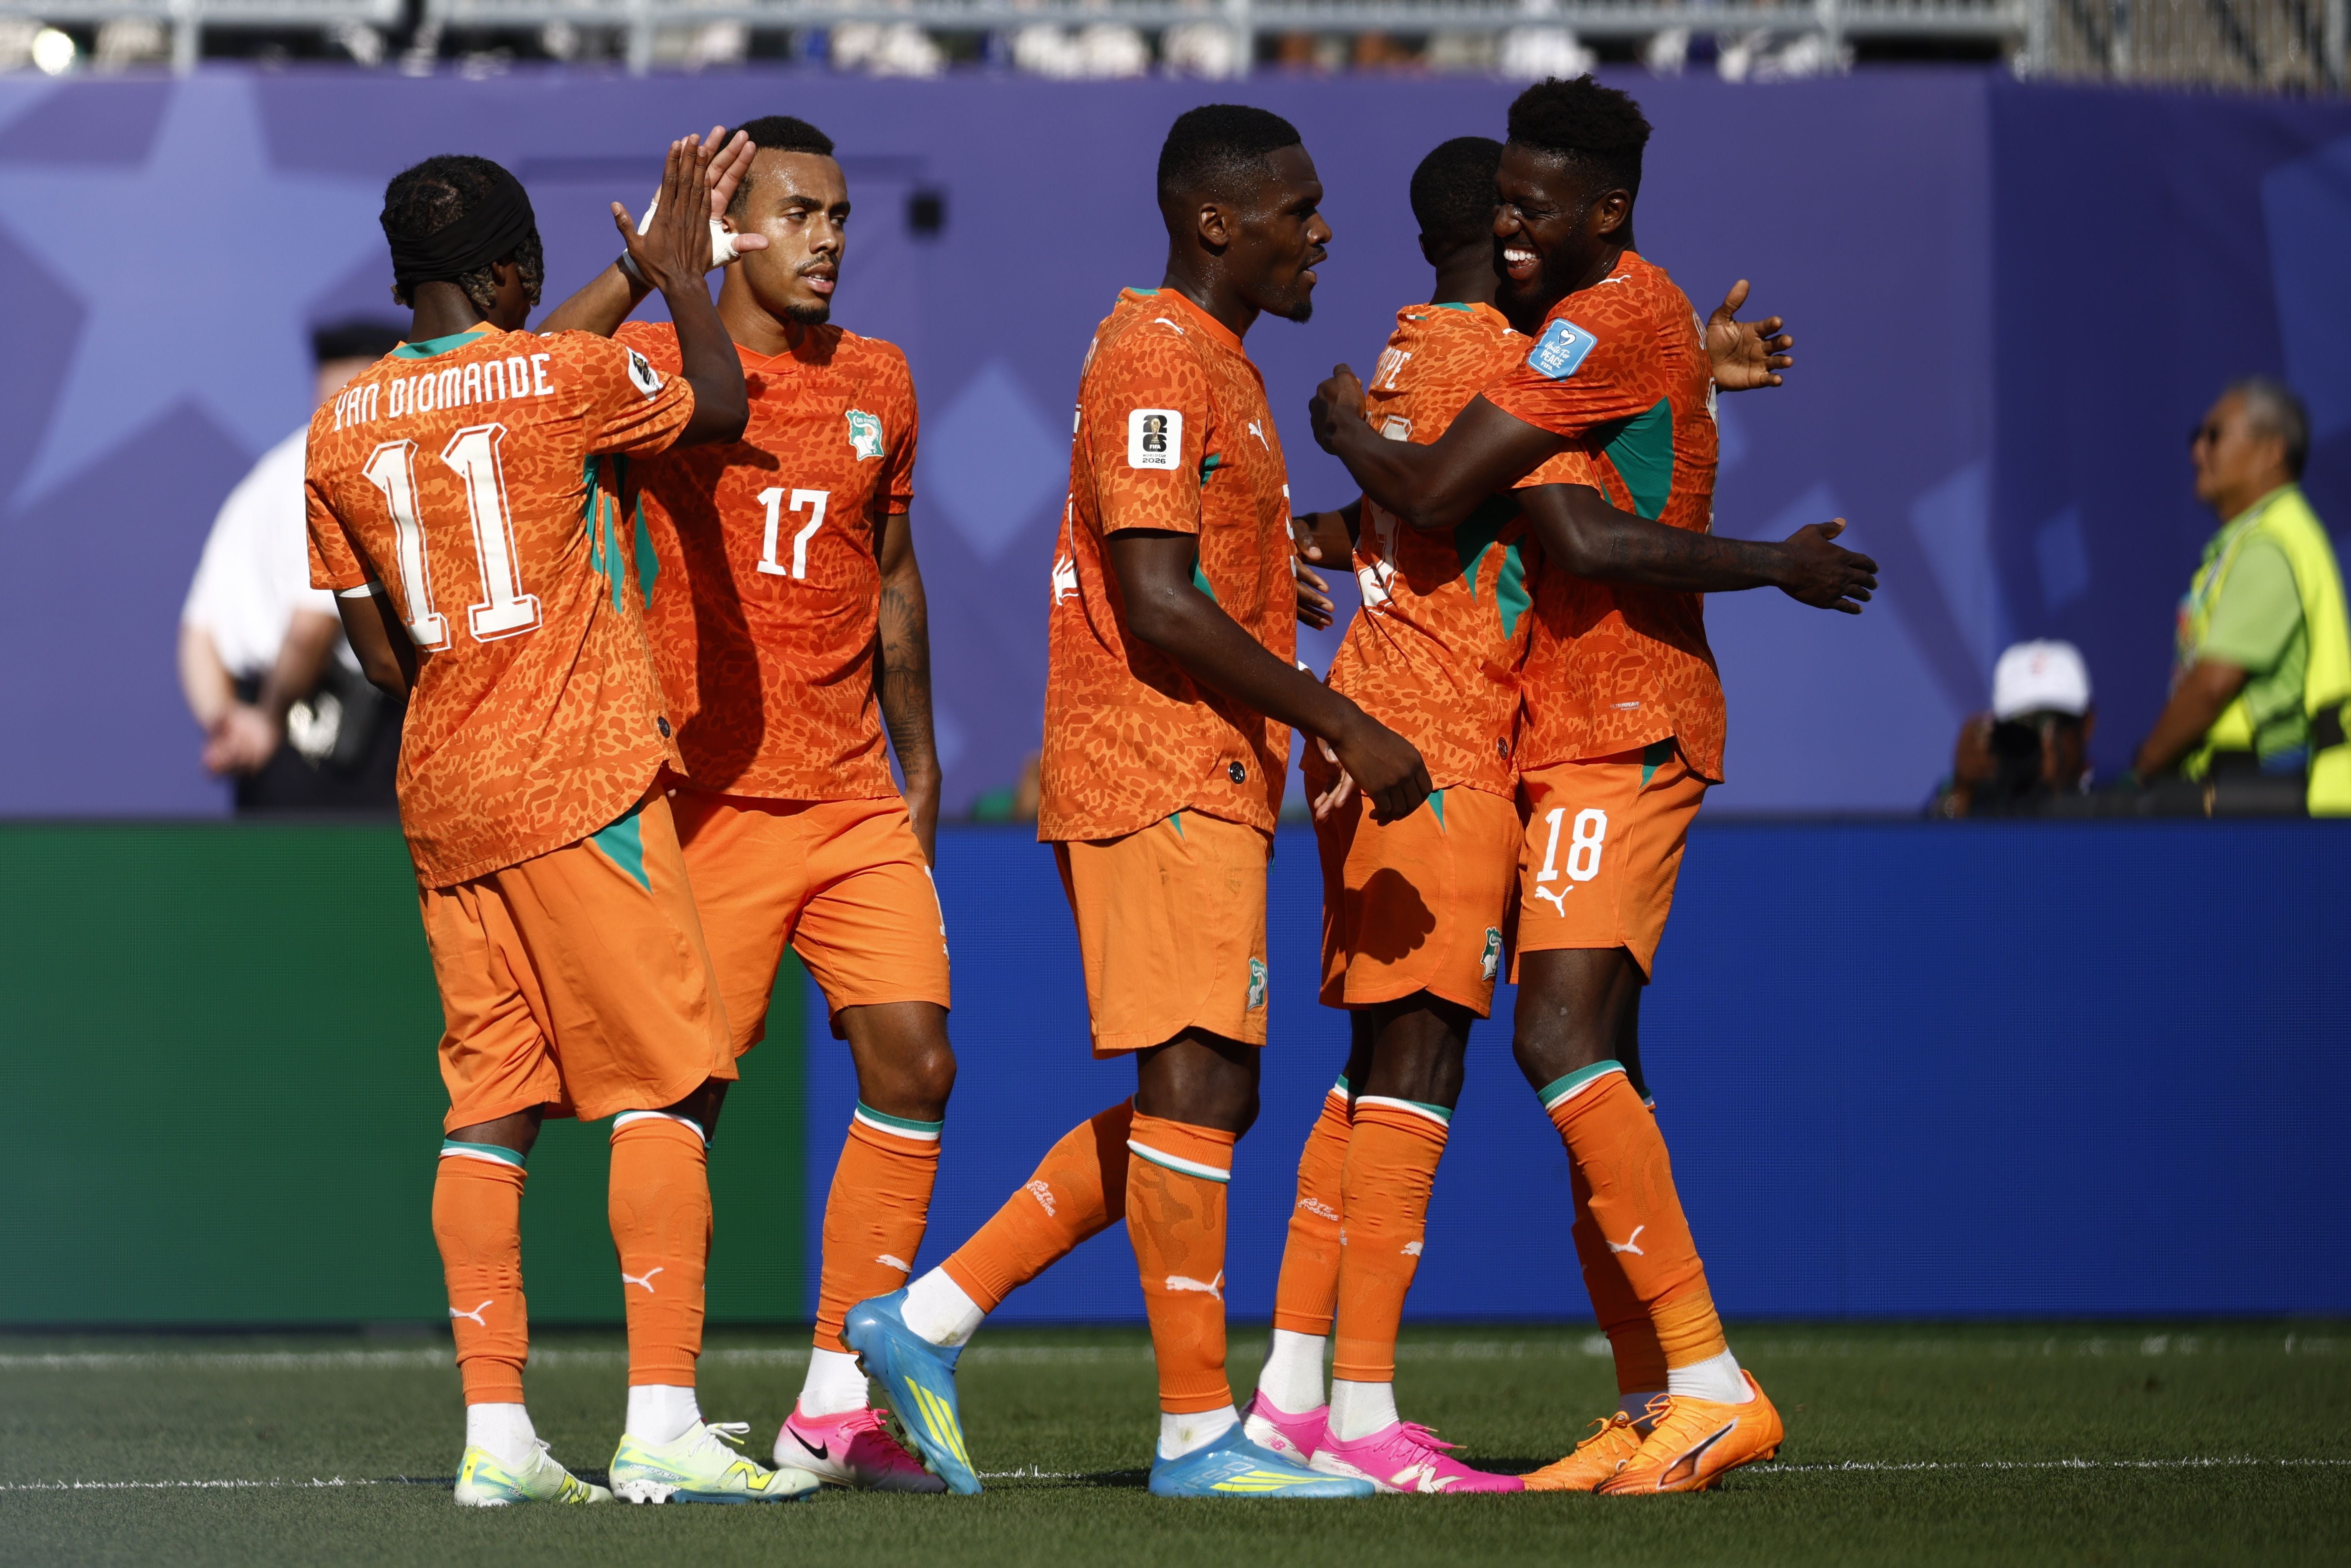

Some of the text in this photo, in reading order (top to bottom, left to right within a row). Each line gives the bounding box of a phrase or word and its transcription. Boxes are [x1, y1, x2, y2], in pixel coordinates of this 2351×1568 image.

[1540, 350, 1565, 369] PEACE
[1540, 361, 1553, 372] FIFA
[1545, 341, 1570, 359] Unite For
[334, 353, 554, 432] YAN DIOMANDE
[361, 422, 543, 652] 11
[756, 488, 831, 579] 17
[1536, 808, 1608, 882] 18
